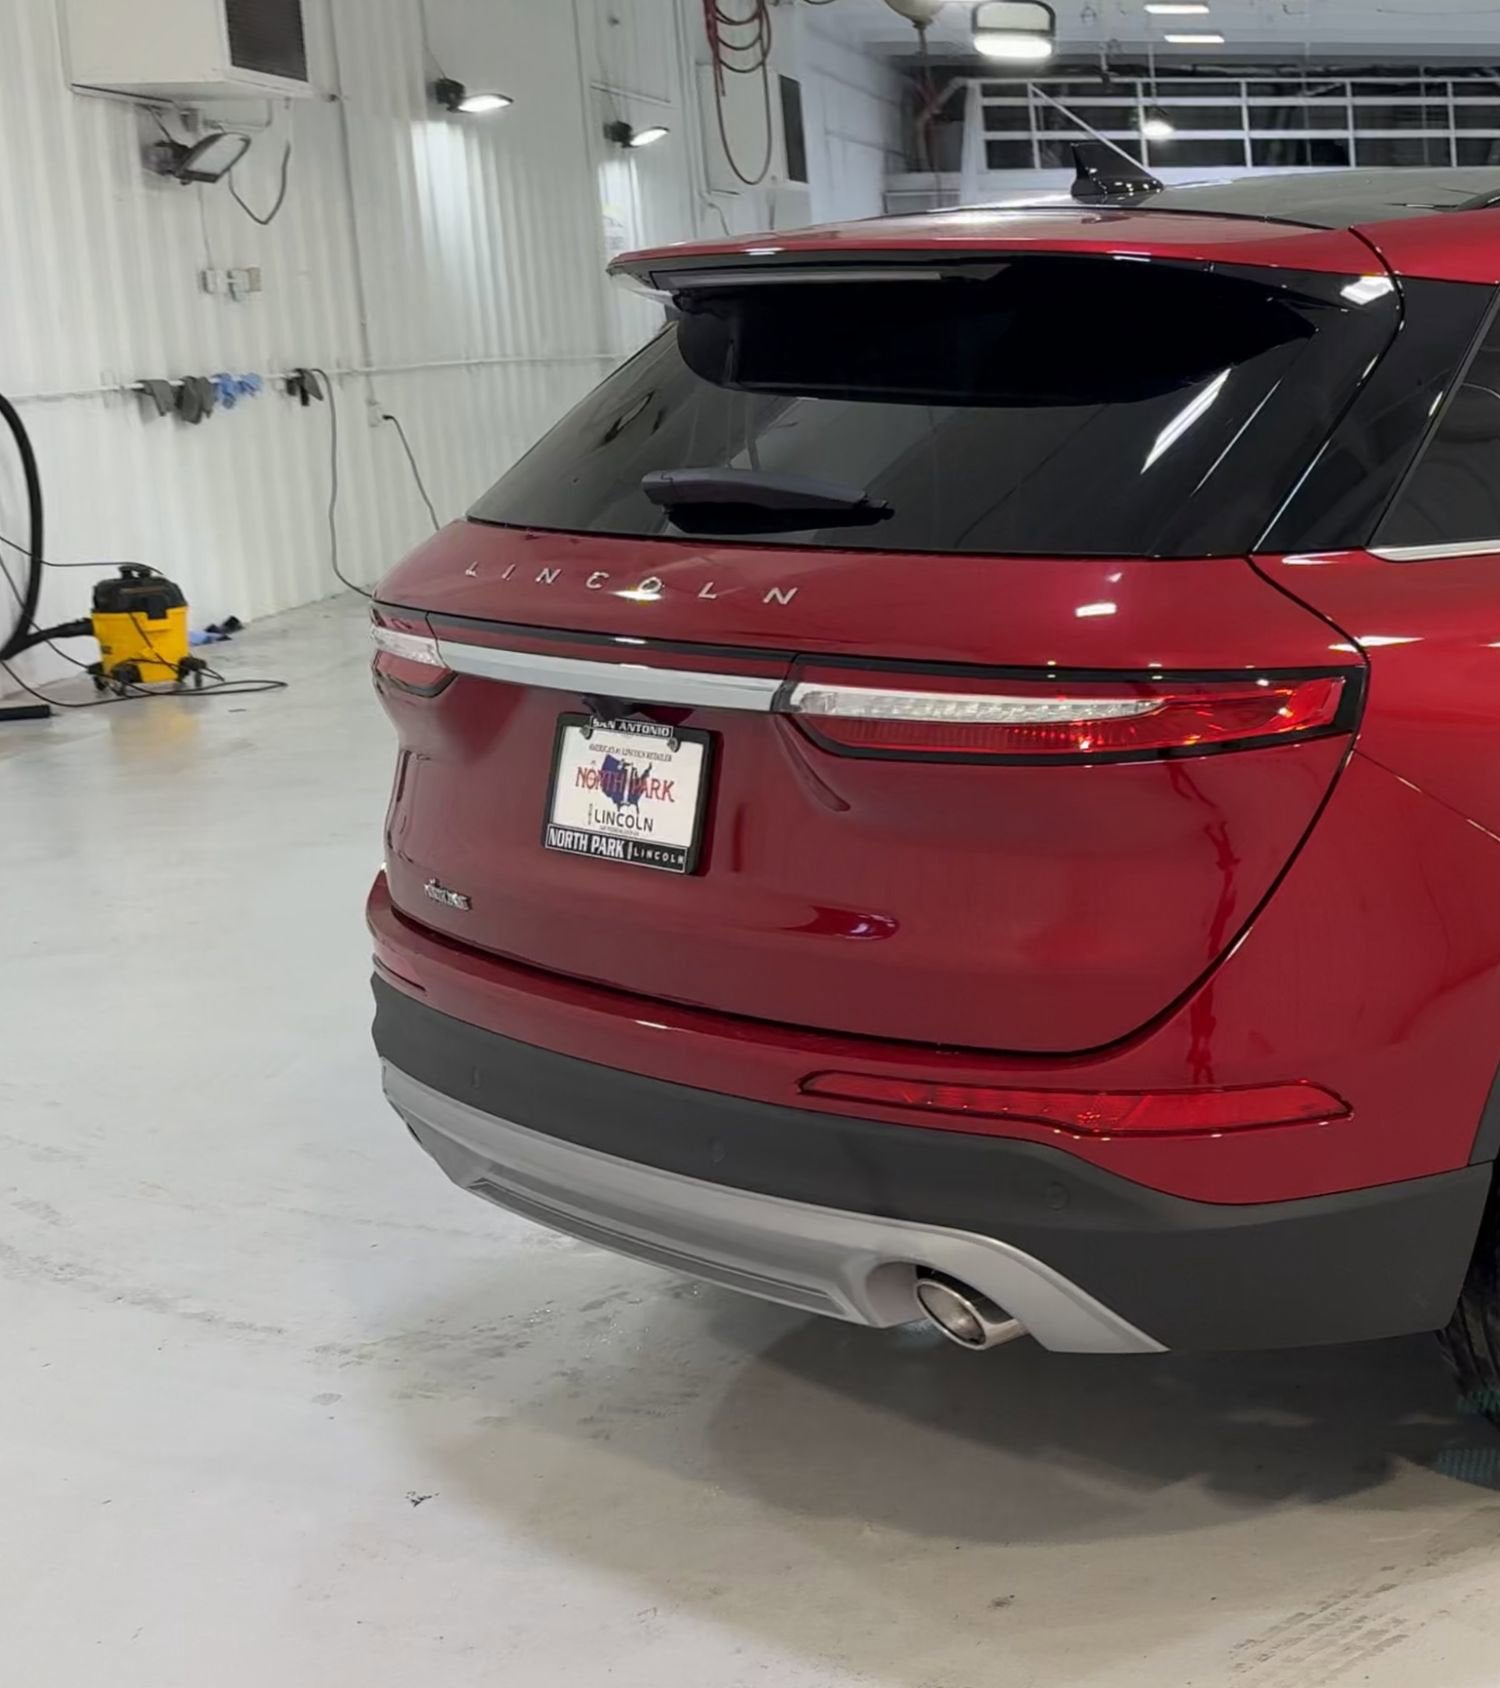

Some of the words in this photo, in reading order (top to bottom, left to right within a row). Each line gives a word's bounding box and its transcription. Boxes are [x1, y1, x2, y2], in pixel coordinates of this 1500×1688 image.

[465, 561, 797, 605] LINCOLN
[593, 719, 615, 729] SAN
[619, 721, 670, 737] ANTONIO
[575, 766, 624, 794] NORTH
[631, 773, 675, 803] PARK
[594, 809, 654, 833] LINCOLN
[549, 828, 588, 852] NORTH
[591, 835, 625, 858] PARK
[633, 848, 684, 864] LINCOLN
